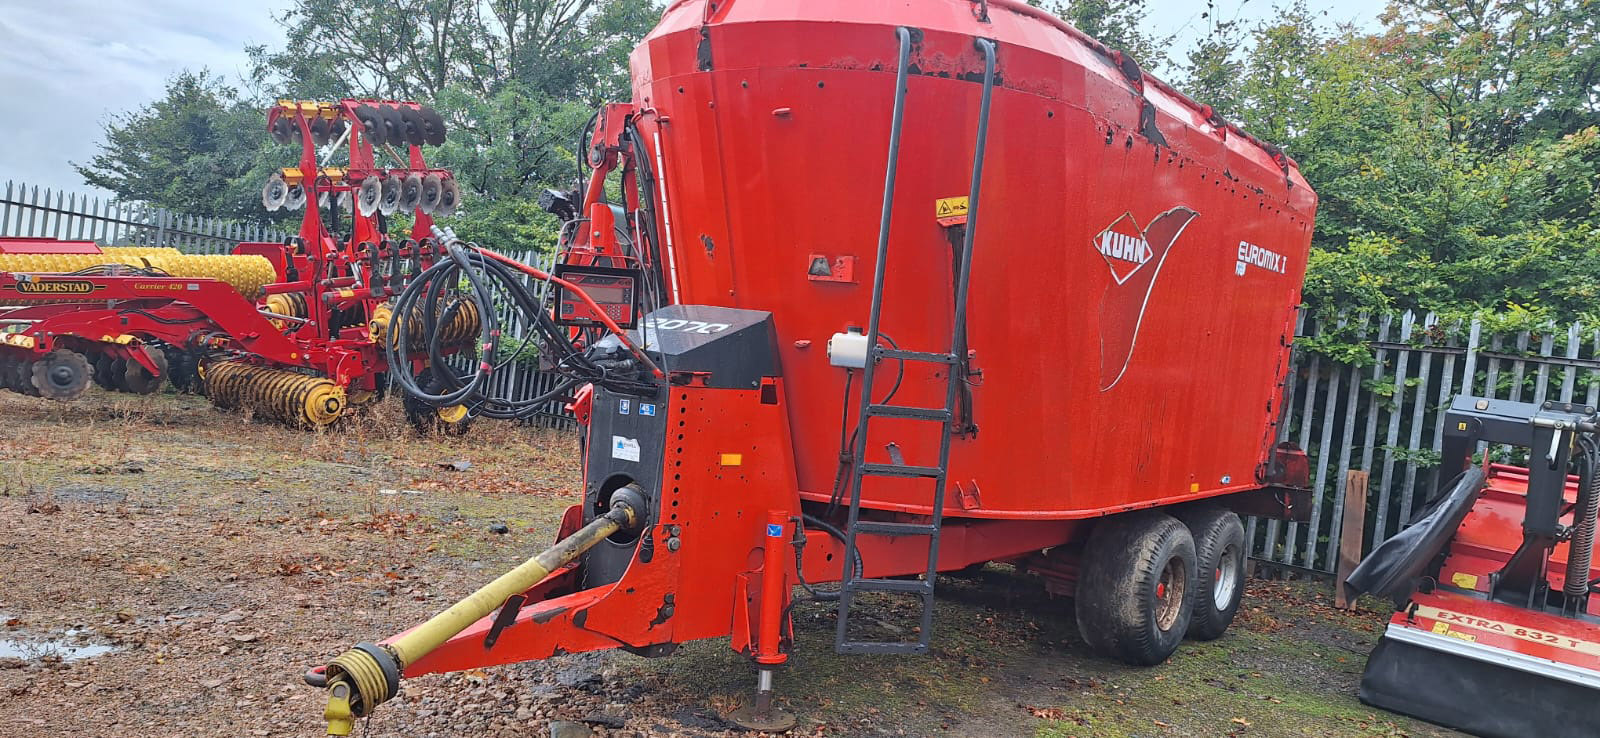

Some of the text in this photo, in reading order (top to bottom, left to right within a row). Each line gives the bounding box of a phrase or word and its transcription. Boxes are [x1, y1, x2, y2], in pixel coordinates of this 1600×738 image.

[1101, 230, 1146, 264] KUHN
[1238, 240, 1281, 273] EUROMIX
[134, 282, 166, 290] Carrier
[640, 318, 730, 334] 2070
[1437, 611, 1581, 648] EXTRA 832 T
